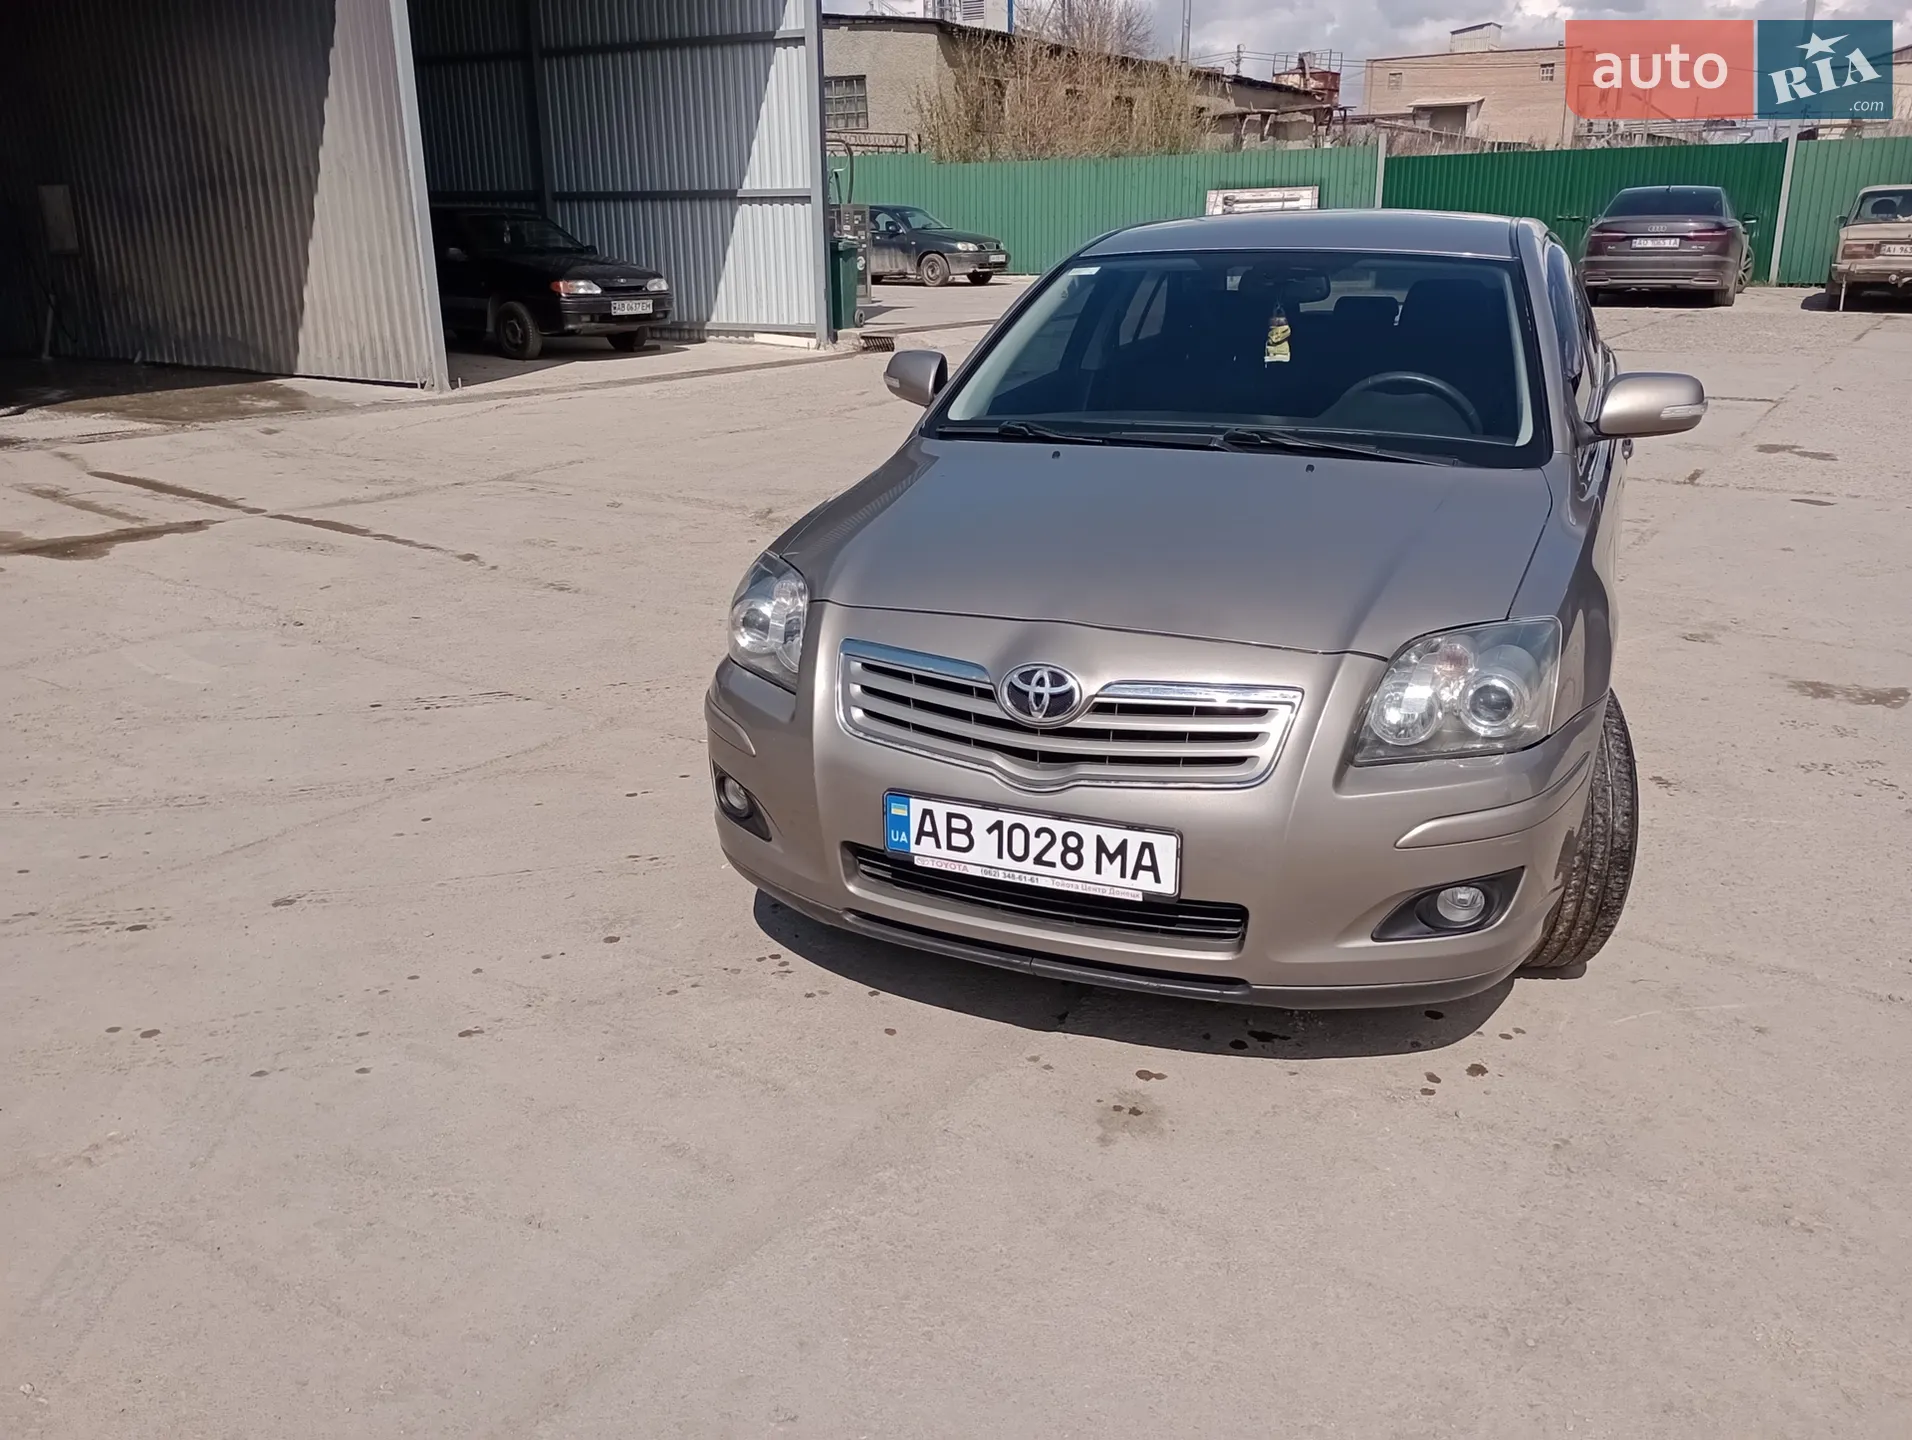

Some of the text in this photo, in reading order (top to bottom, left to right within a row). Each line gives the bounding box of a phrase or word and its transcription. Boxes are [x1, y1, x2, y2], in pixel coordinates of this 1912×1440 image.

[617, 303, 626, 311] AB
[891, 830, 908, 843] UA
[914, 808, 1162, 884] AB 1028 MA
[931, 857, 969, 873] TOYOTA
[1081, 883, 1107, 894] Центр
